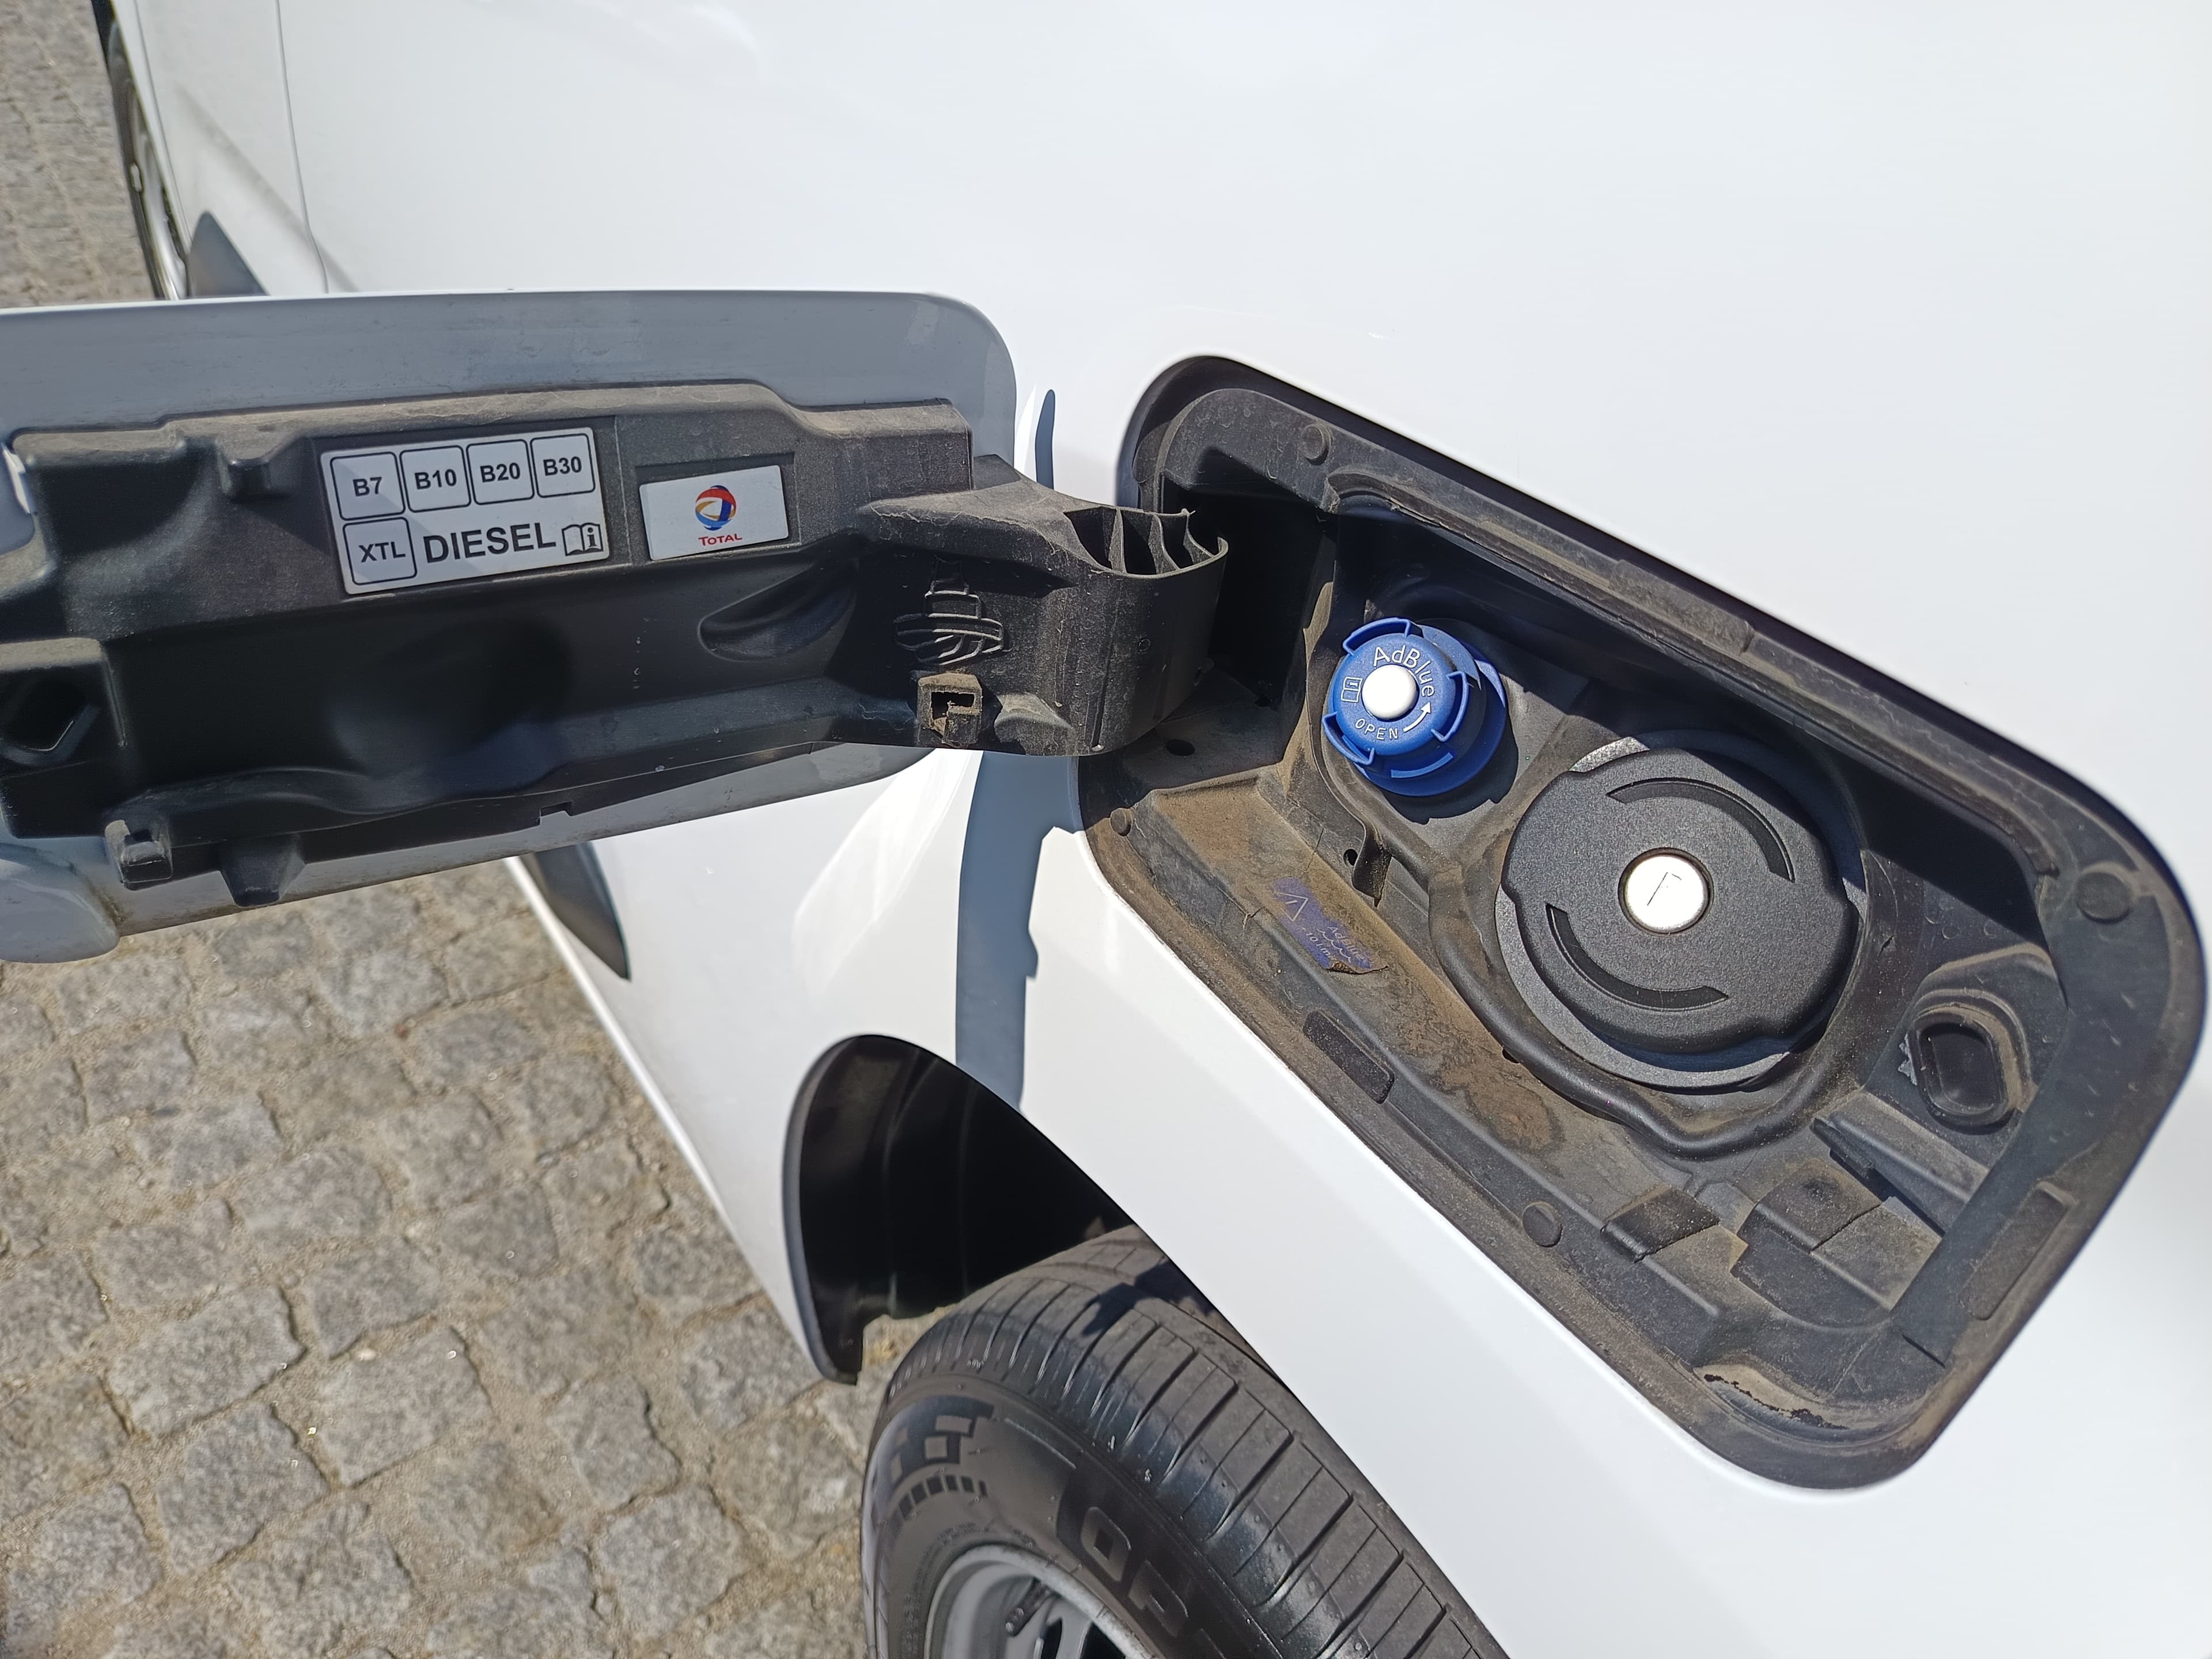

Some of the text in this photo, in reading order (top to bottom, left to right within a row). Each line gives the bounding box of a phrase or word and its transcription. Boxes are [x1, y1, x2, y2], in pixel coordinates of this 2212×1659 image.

[353, 456, 582, 497] B7 B10 B20 B30
[358, 522, 556, 563] XTL DIESEL
[698, 533, 743, 546] TOTAL
[1373, 645, 1434, 697] AdBlue
[1355, 718, 1398, 740] OPEN
